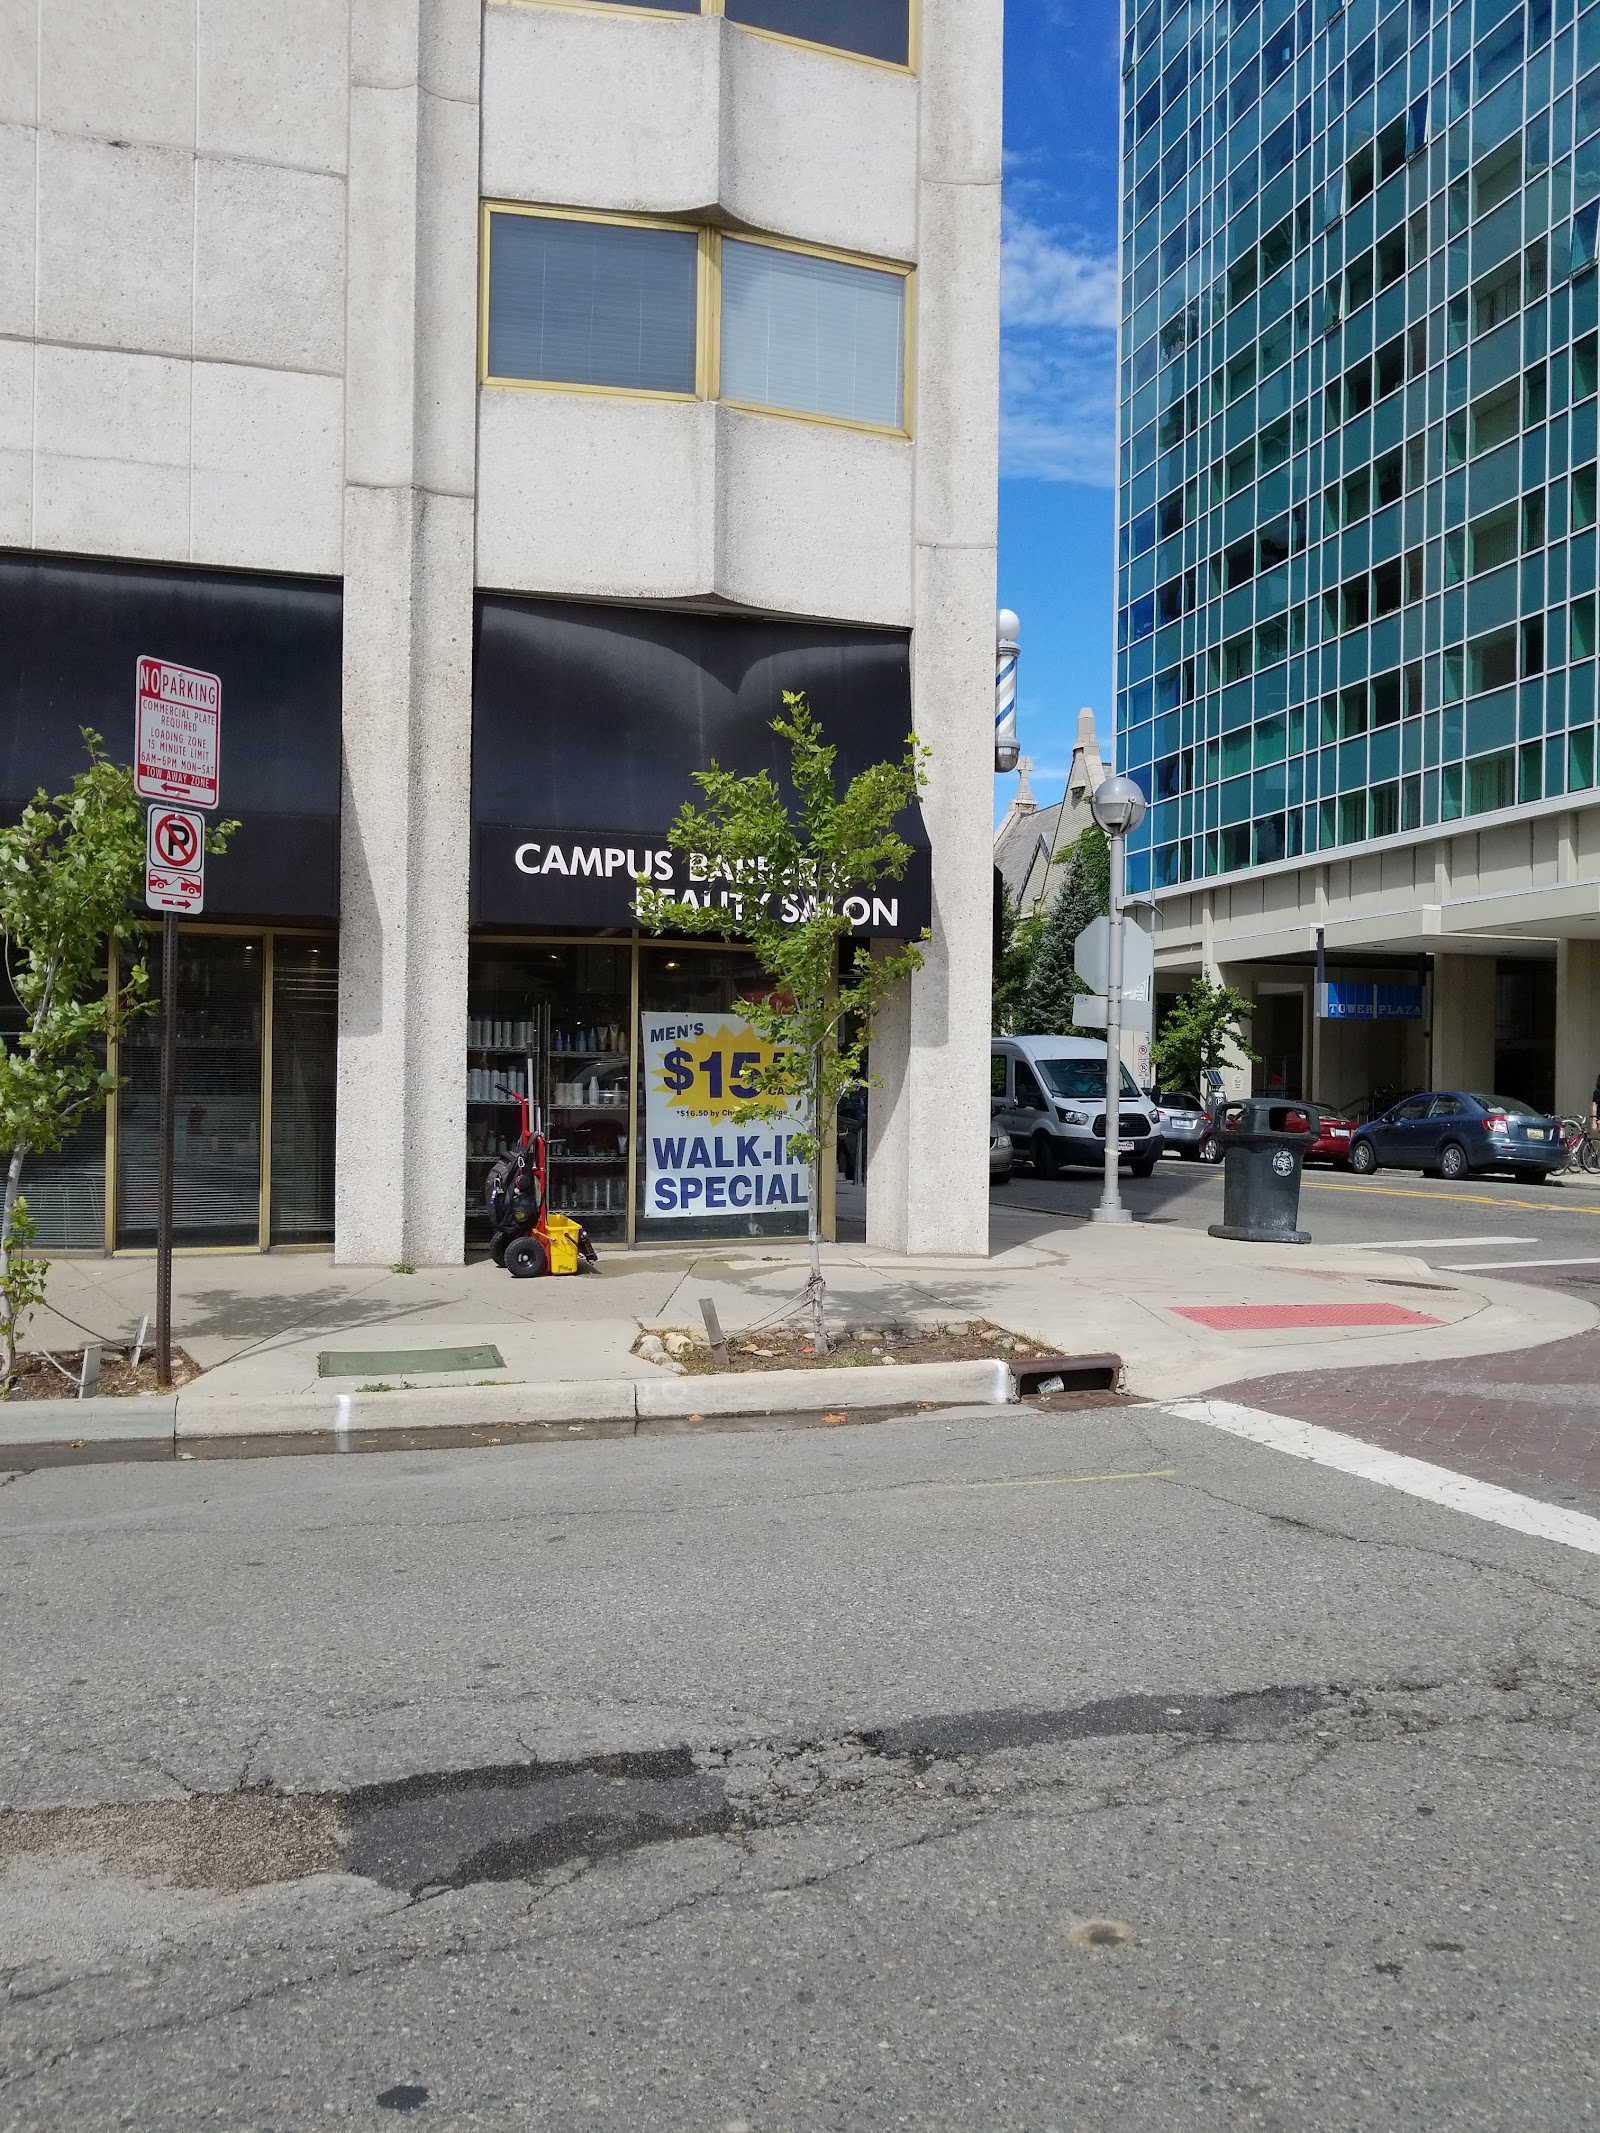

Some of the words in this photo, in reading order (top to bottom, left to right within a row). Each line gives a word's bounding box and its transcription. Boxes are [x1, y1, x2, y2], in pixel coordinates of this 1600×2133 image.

[140, 665, 160, 694] NO
[162, 674, 216, 705] PARKING
[142, 699, 190, 720] COMMERCIAL
[194, 711, 215, 726] PLATE
[161, 715, 197, 732] REQUIRED
[150, 727, 184, 744] LOADING
[187, 735, 207, 749] ZONE
[148, 739, 155, 749] 15
[159, 741, 186, 756] MINUTE
[190, 748, 209, 761] LIMIT
[145, 765, 163, 779] TOW
[166, 770, 188, 784] AWAY
[190, 775, 209, 788] ZONE
[515, 843, 674, 881] CAMPUS
[1328, 1003, 1374, 1014] TOWER
[1378, 1004, 1421, 1015] PLAZA
[650, 1022, 704, 1043] MEN'S
[710, 1110, 720, 1118] by
[654, 1173, 809, 1211] SPECIAL
